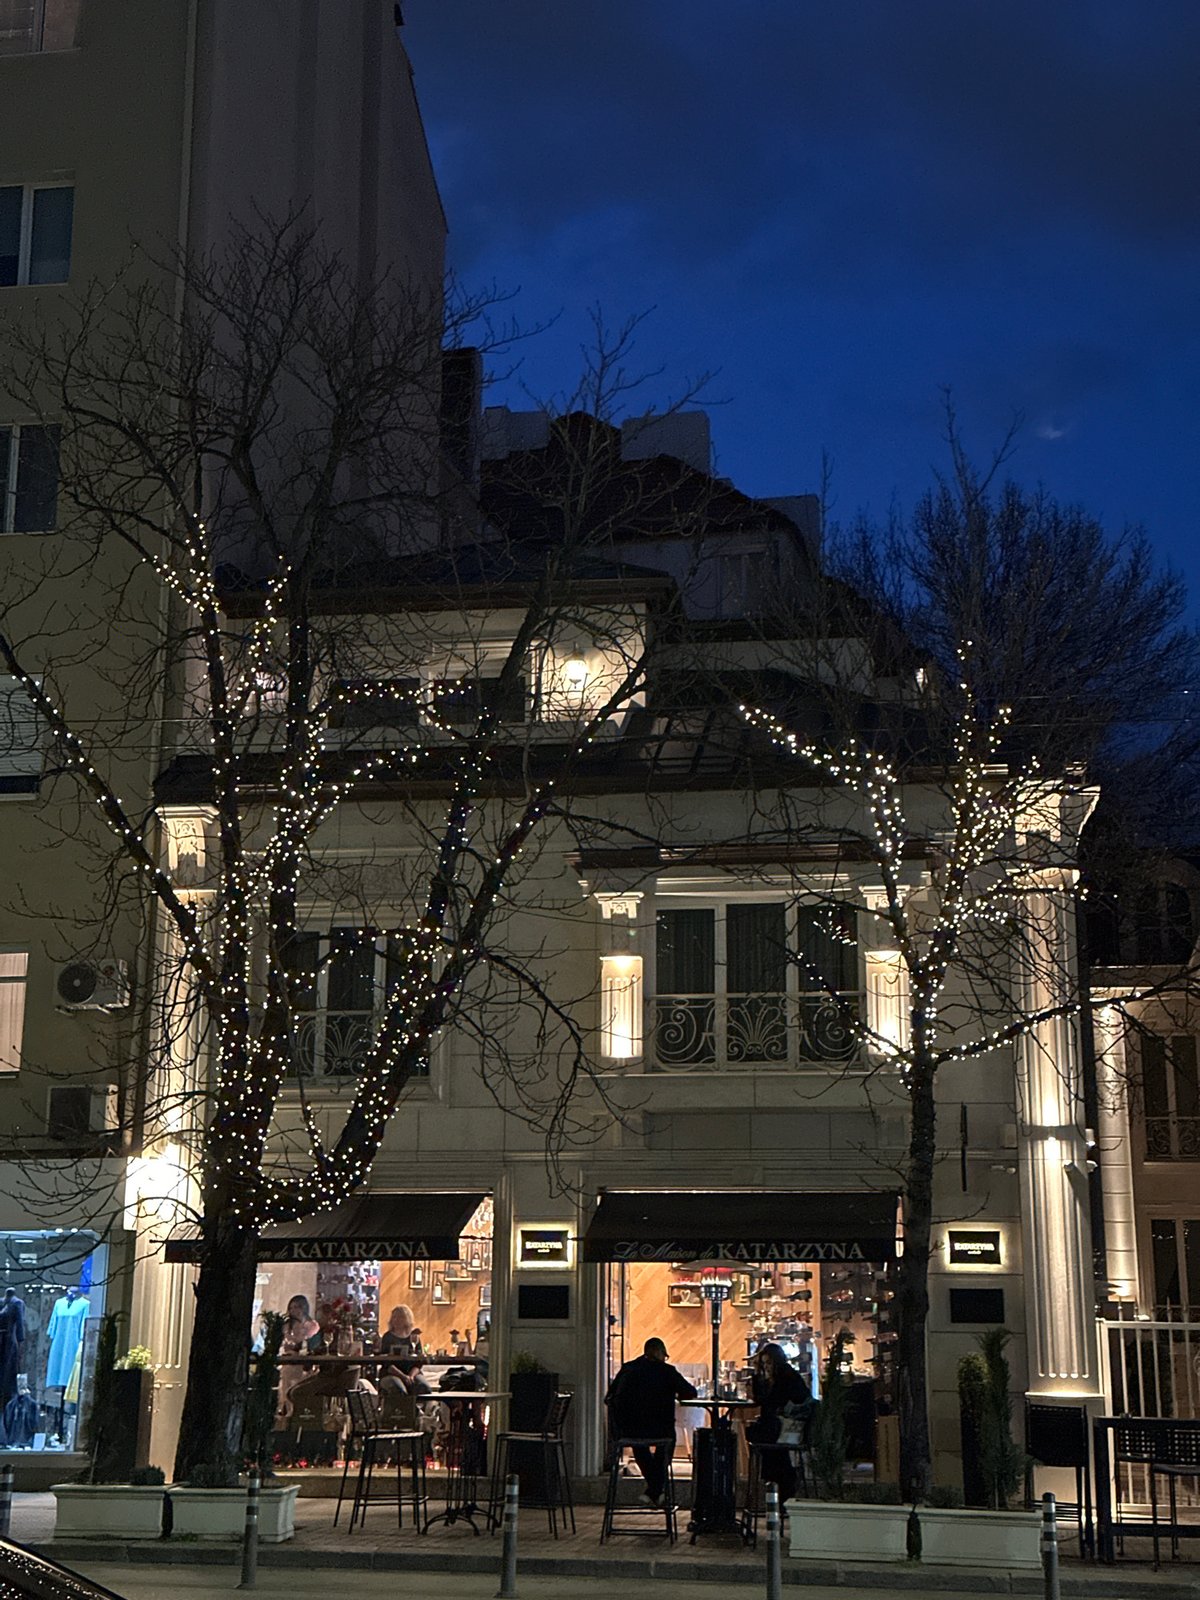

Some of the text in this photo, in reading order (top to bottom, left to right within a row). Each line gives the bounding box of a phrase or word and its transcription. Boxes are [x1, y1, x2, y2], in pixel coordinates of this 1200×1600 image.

[291, 1241, 431, 1259] KATARZYNA
[614, 1242, 865, 1260] La Maison de KATARZYNA
